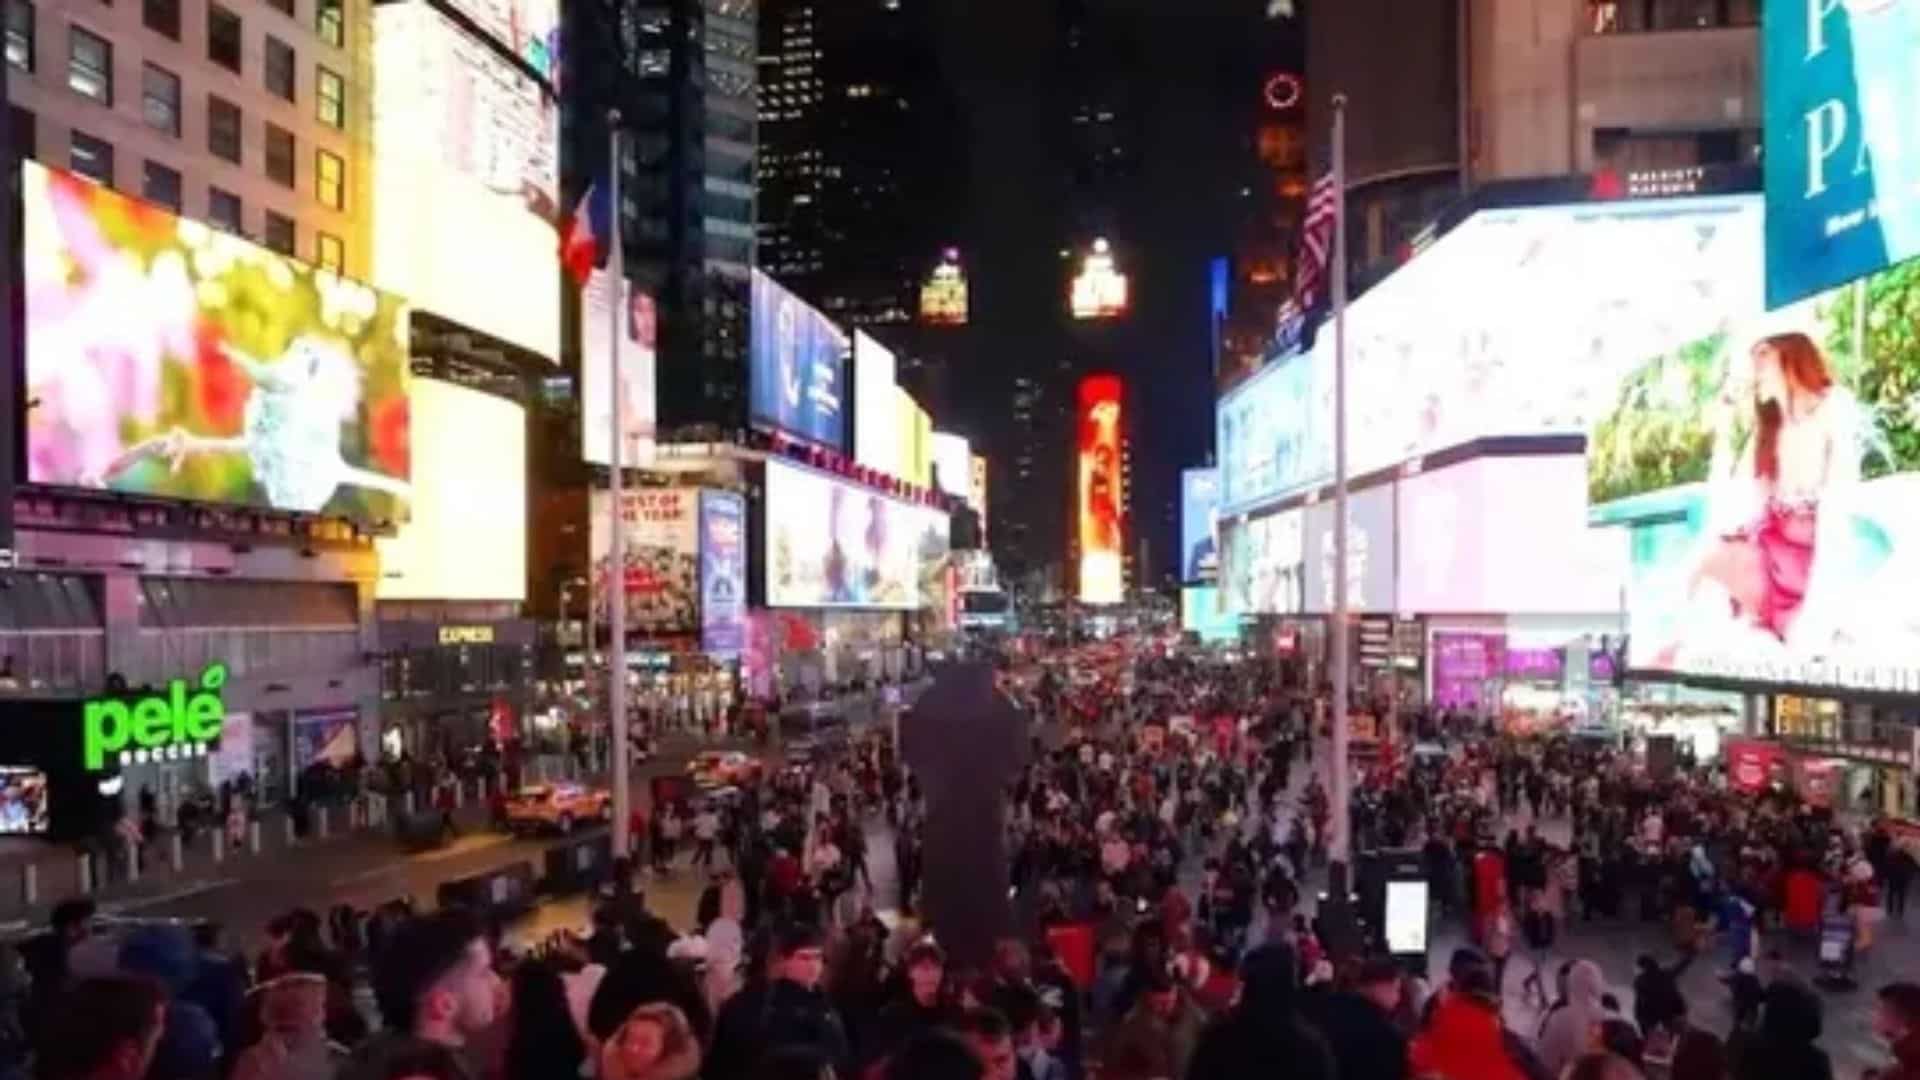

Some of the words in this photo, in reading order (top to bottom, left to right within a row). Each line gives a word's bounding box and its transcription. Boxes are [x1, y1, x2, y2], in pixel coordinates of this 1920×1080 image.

[439, 625, 494, 643] EXPRESS
[84, 664, 226, 770] pelé
[119, 742, 207, 766] SOCCER
